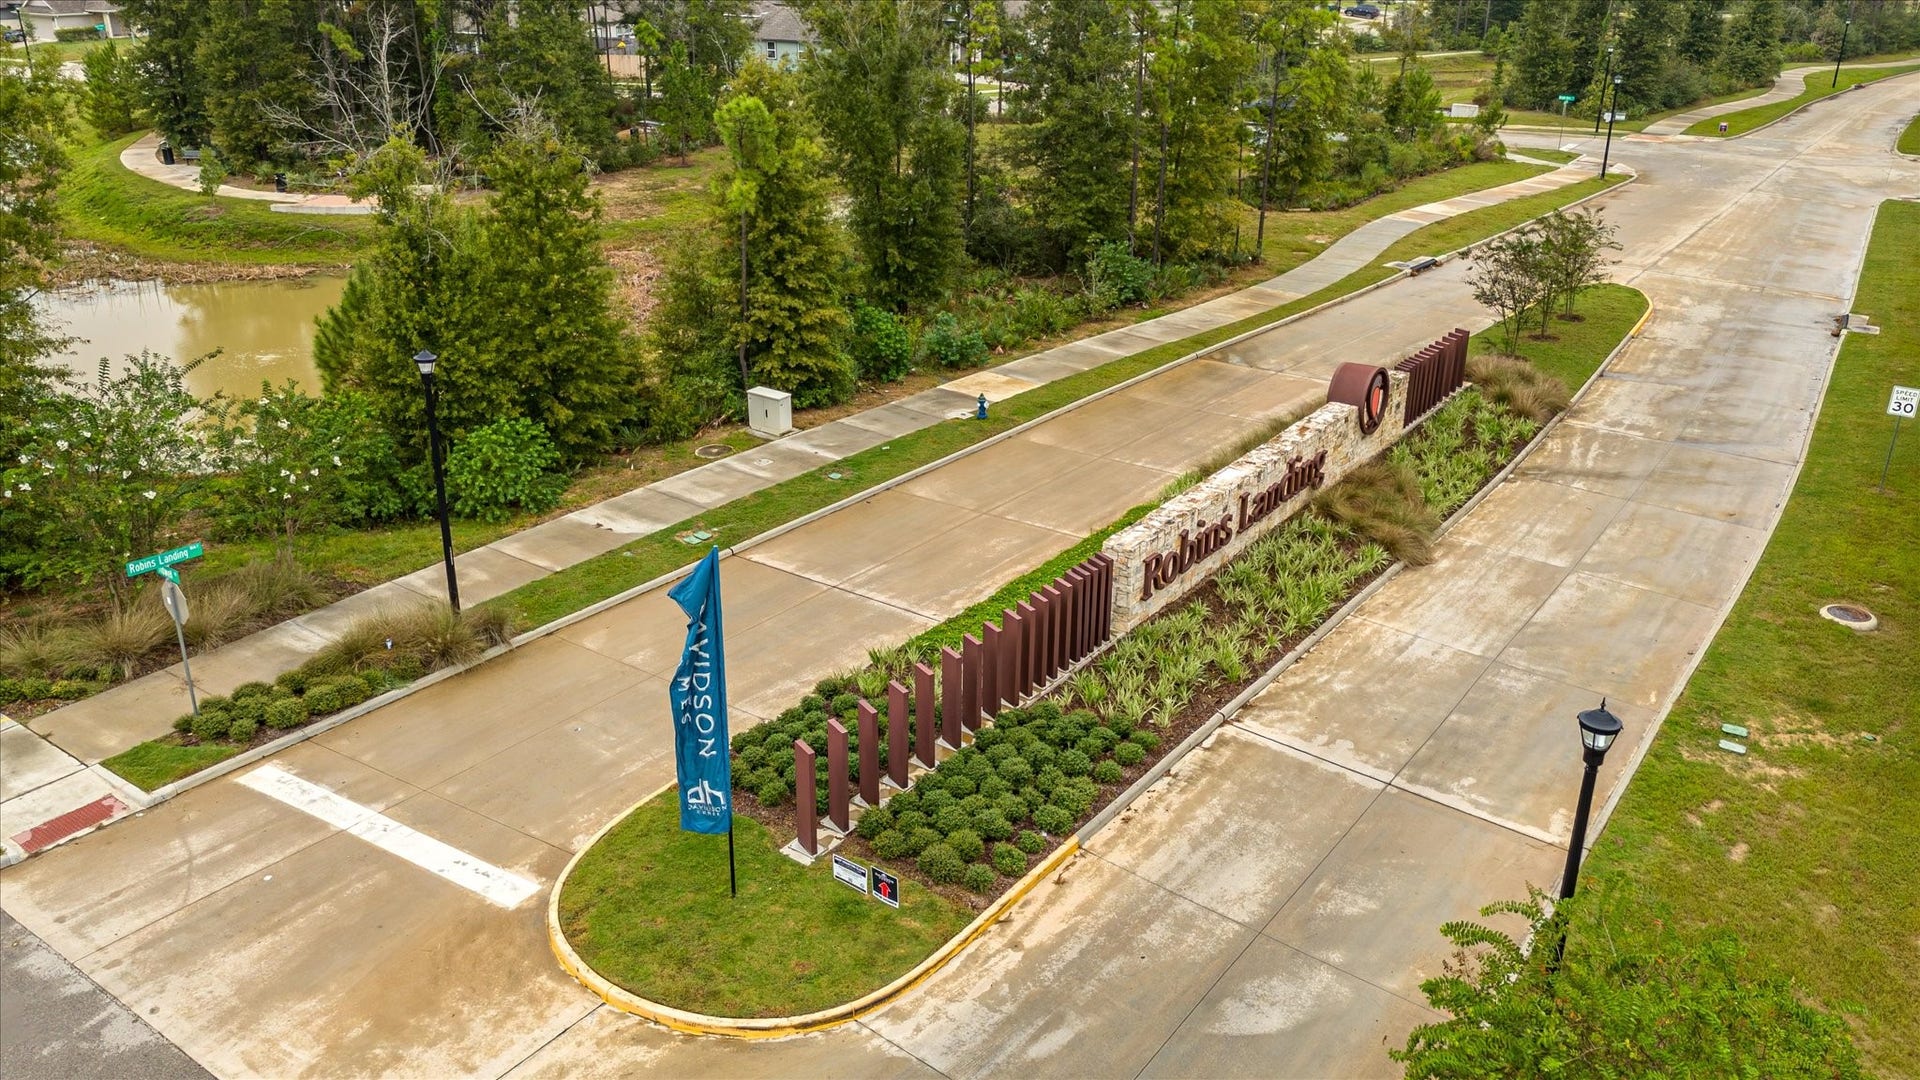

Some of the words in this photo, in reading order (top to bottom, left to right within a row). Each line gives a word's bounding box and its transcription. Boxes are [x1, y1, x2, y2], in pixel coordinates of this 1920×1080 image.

[1895, 389, 1918, 398] SPEED
[1892, 401, 1914, 414] 30
[1140, 513, 1233, 601] Robins
[1236, 449, 1328, 534] Landing
[128, 559, 156, 574] Robins
[158, 549, 189, 566] Landing
